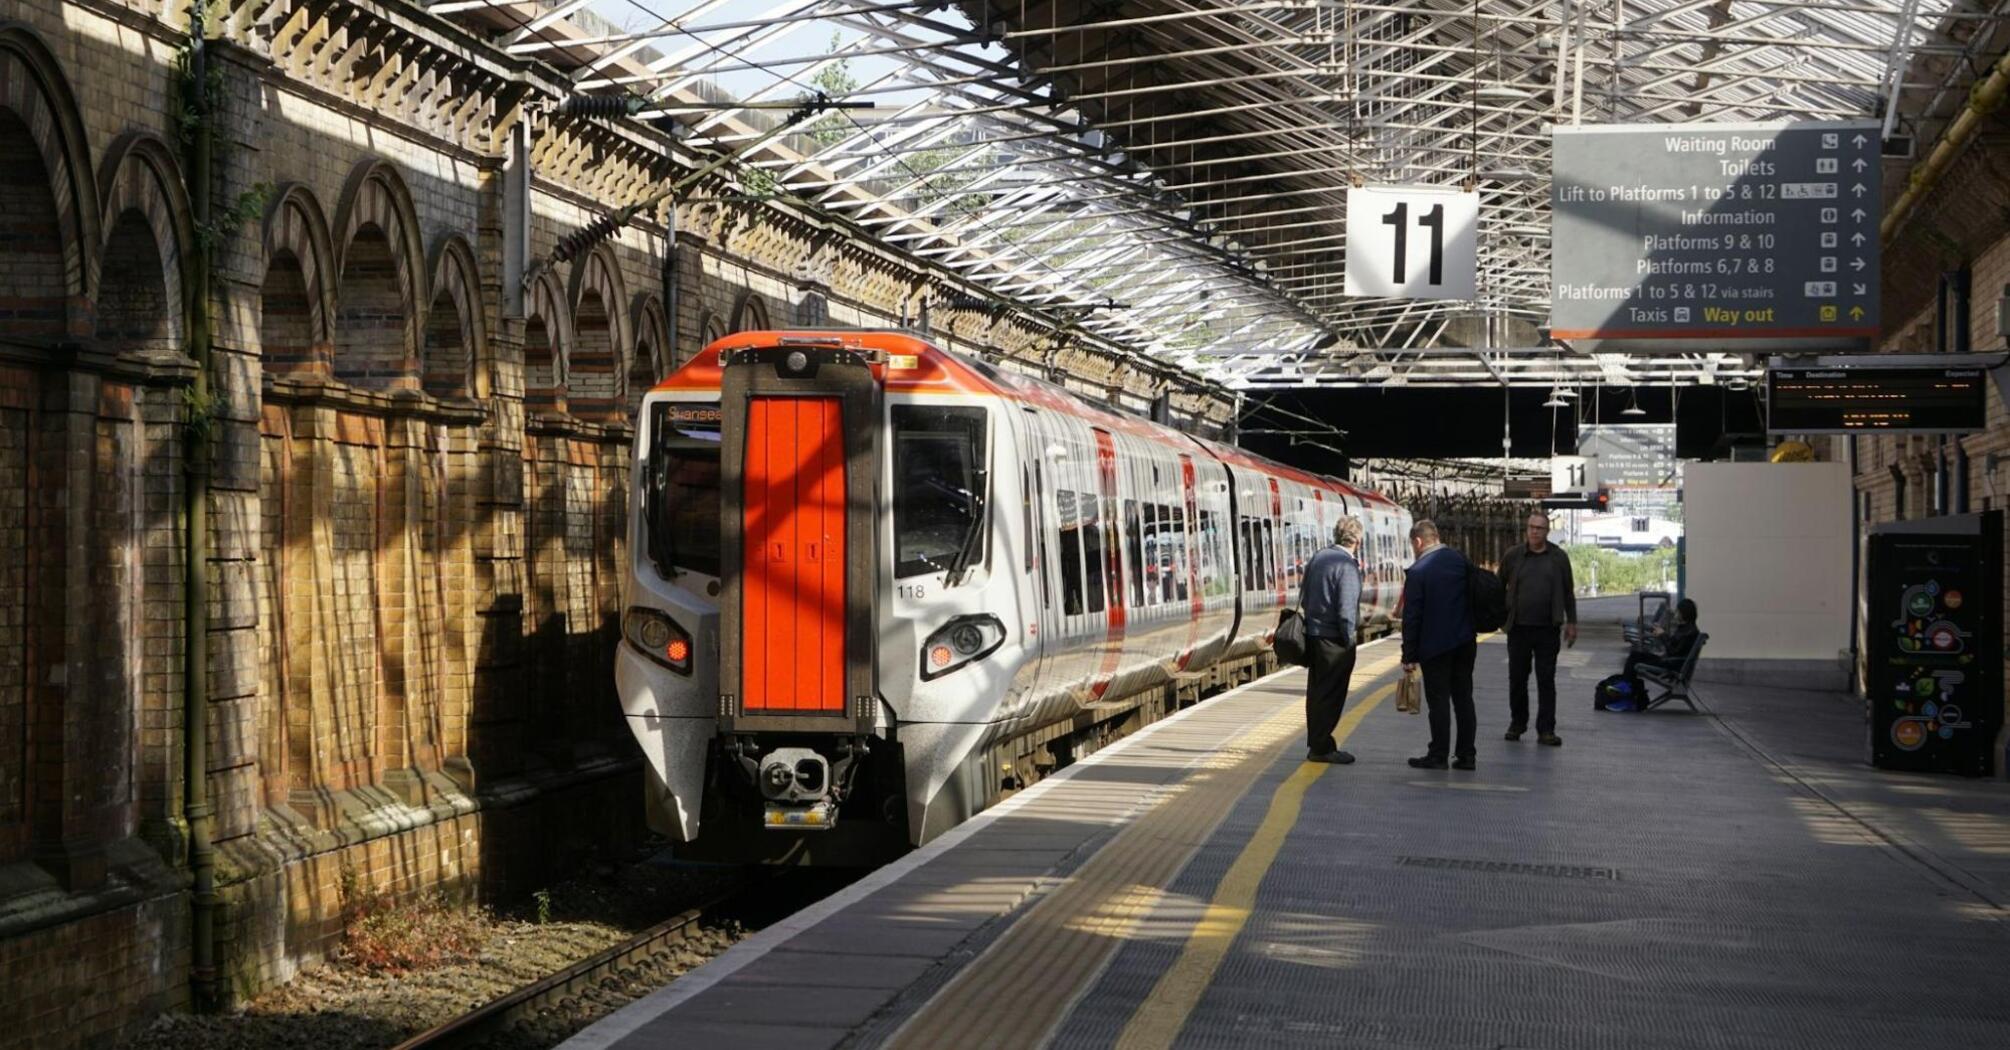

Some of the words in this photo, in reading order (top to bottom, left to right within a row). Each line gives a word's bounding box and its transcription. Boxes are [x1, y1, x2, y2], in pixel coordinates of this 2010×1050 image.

[1665, 136, 1727, 155] Waiting
[1731, 135, 1776, 150] Room
[1720, 159, 1775, 175] Toilets
[1559, 186, 1586, 202] Lift
[1589, 187, 1605, 201] to
[1610, 185, 1685, 201] Platforms
[1690, 185, 1698, 199] 1
[1704, 186, 1721, 200] to
[1725, 184, 1736, 199] 5
[1740, 184, 1753, 199] &
[1758, 183, 1775, 198] 12
[1681, 209, 1775, 225] Information
[1382, 202, 1444, 286] 11
[1644, 235, 1720, 251] Platforms
[1723, 235, 1735, 249] 9
[1739, 235, 1752, 249] &
[1758, 234, 1775, 248] 10
[1636, 258, 1713, 275] Platforms
[1716, 259, 1742, 275] 6,7
[1746, 259, 1760, 273] &
[1765, 258, 1775, 273] 8
[1558, 283, 1631, 300] Platforms
[1635, 284, 1643, 299] 1
[1649, 285, 1664, 299] to
[1669, 284, 1679, 299] 5
[1683, 284, 1696, 299] &
[1700, 284, 1717, 299] 12
[1721, 286, 1739, 299] via
[1741, 286, 1775, 299] stairs
[1629, 306, 1668, 323] Taxis
[1703, 307, 1740, 326] Way
[1744, 307, 1775, 323] out
[1566, 463, 1586, 487] 11
[1636, 519, 1646, 532] 11
[897, 584, 925, 599] 118
